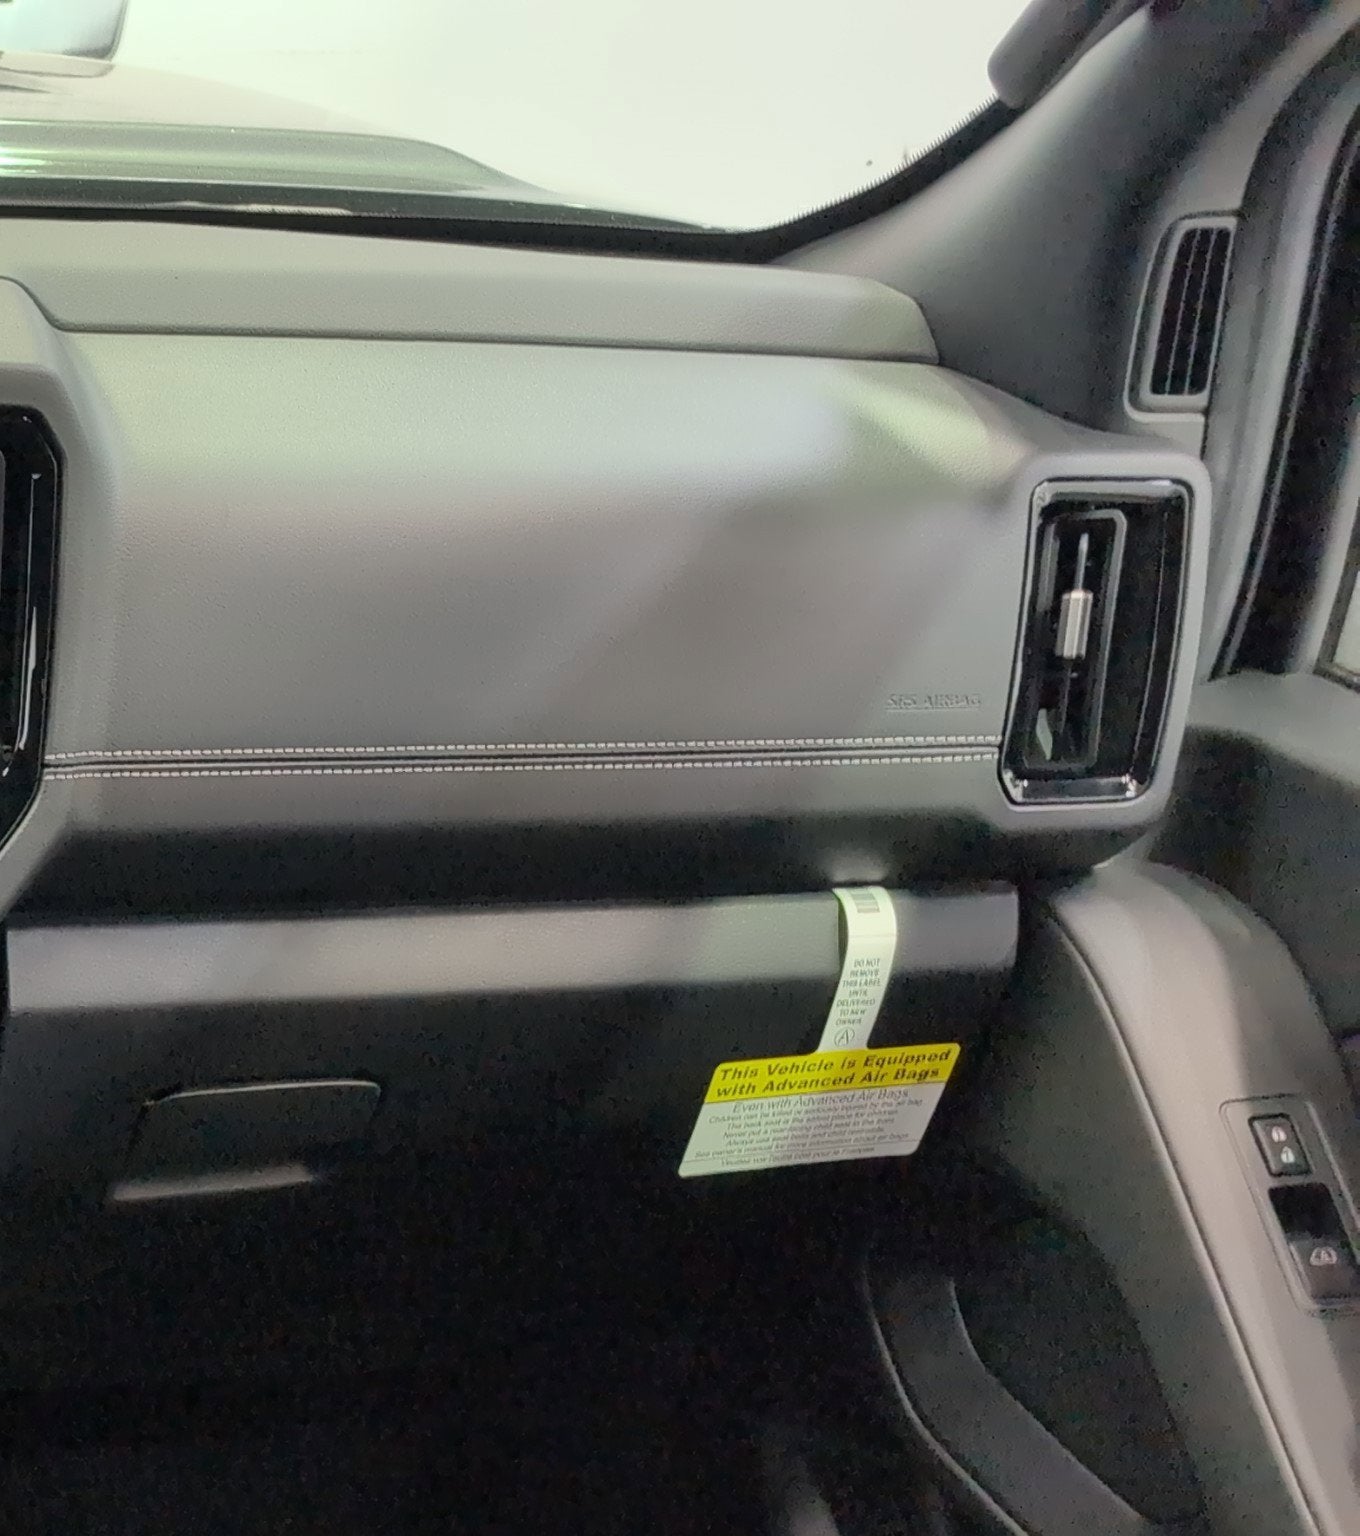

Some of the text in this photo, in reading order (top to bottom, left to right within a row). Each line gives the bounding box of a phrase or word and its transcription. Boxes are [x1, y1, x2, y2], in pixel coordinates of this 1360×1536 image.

[719, 1048, 953, 1081] This Vehicle is Equipped
[716, 1067, 940, 1098] with Advanced Air Bags
